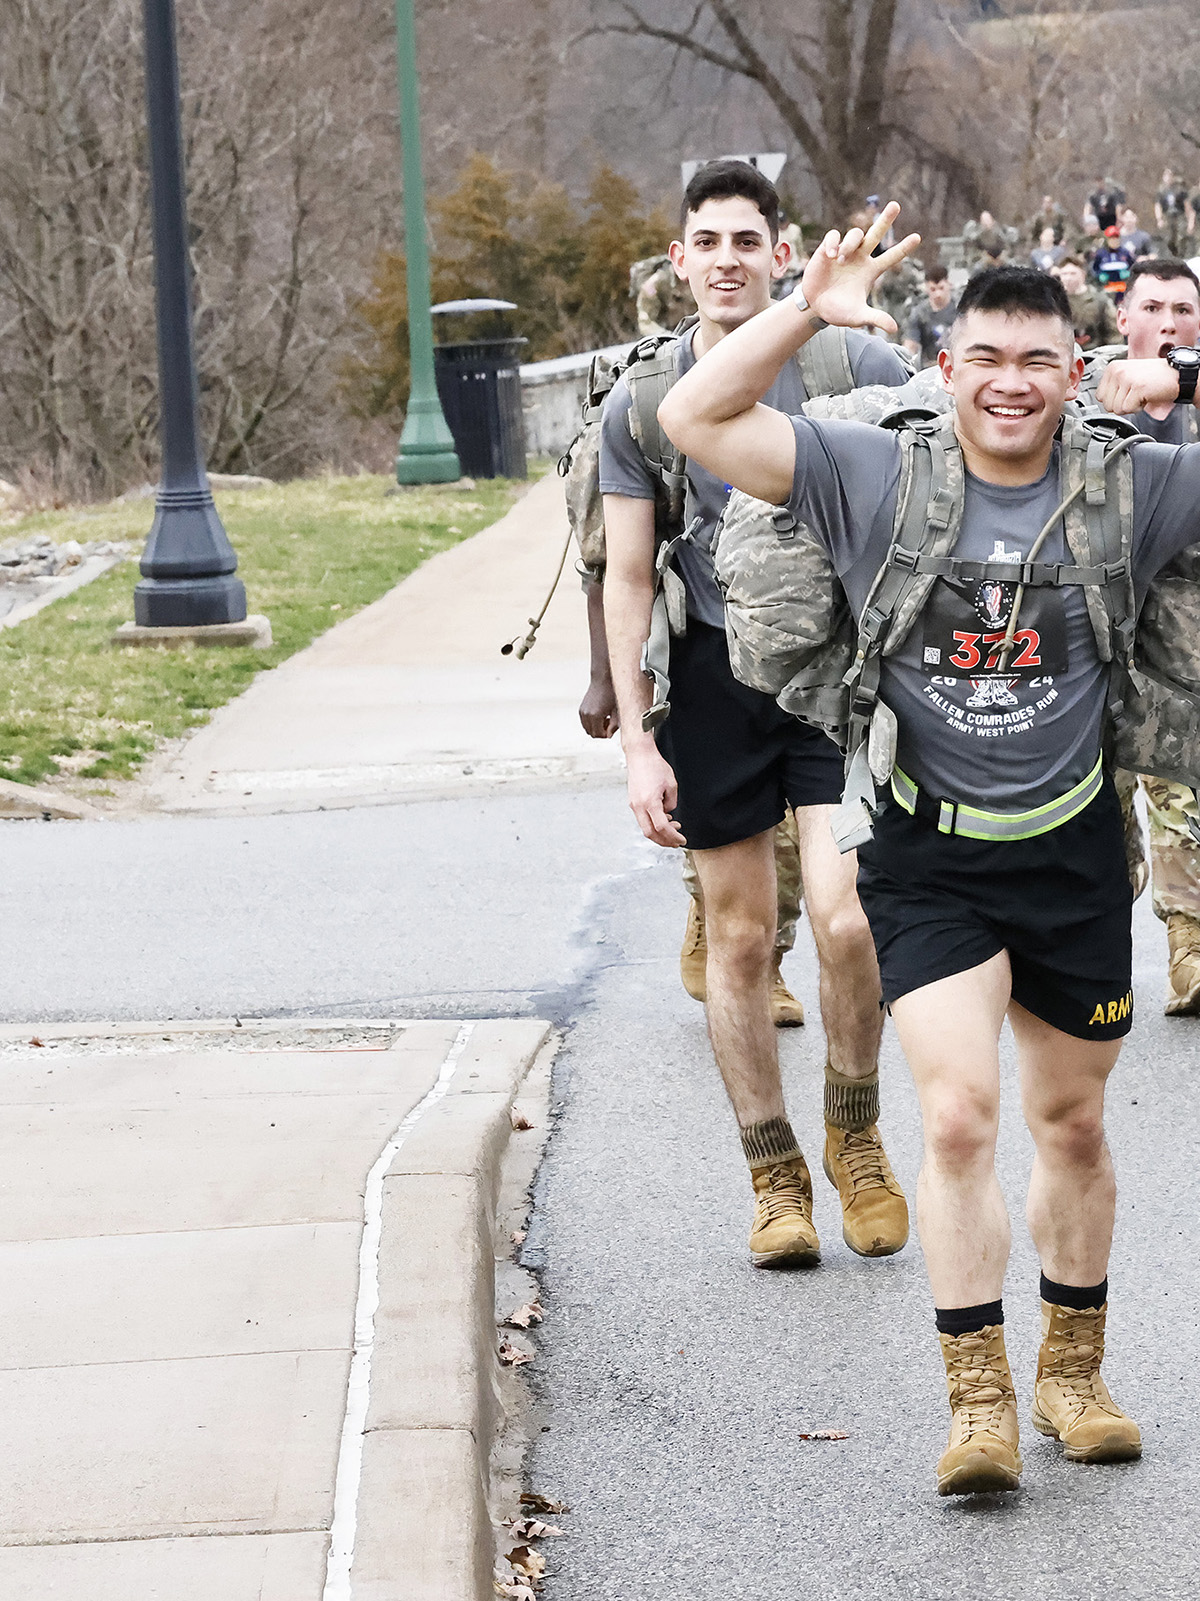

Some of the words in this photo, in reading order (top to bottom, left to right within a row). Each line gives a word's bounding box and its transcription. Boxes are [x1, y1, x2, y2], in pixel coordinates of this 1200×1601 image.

[949, 628, 1042, 669] 372
[923, 685, 965, 718] FALLEN
[966, 705, 1036, 726] COMRADES
[1035, 688, 1059, 711] RUN
[946, 717, 974, 735] ARMY
[976, 727, 1005, 737] WEST
[1006, 719, 1035, 735] POINT
